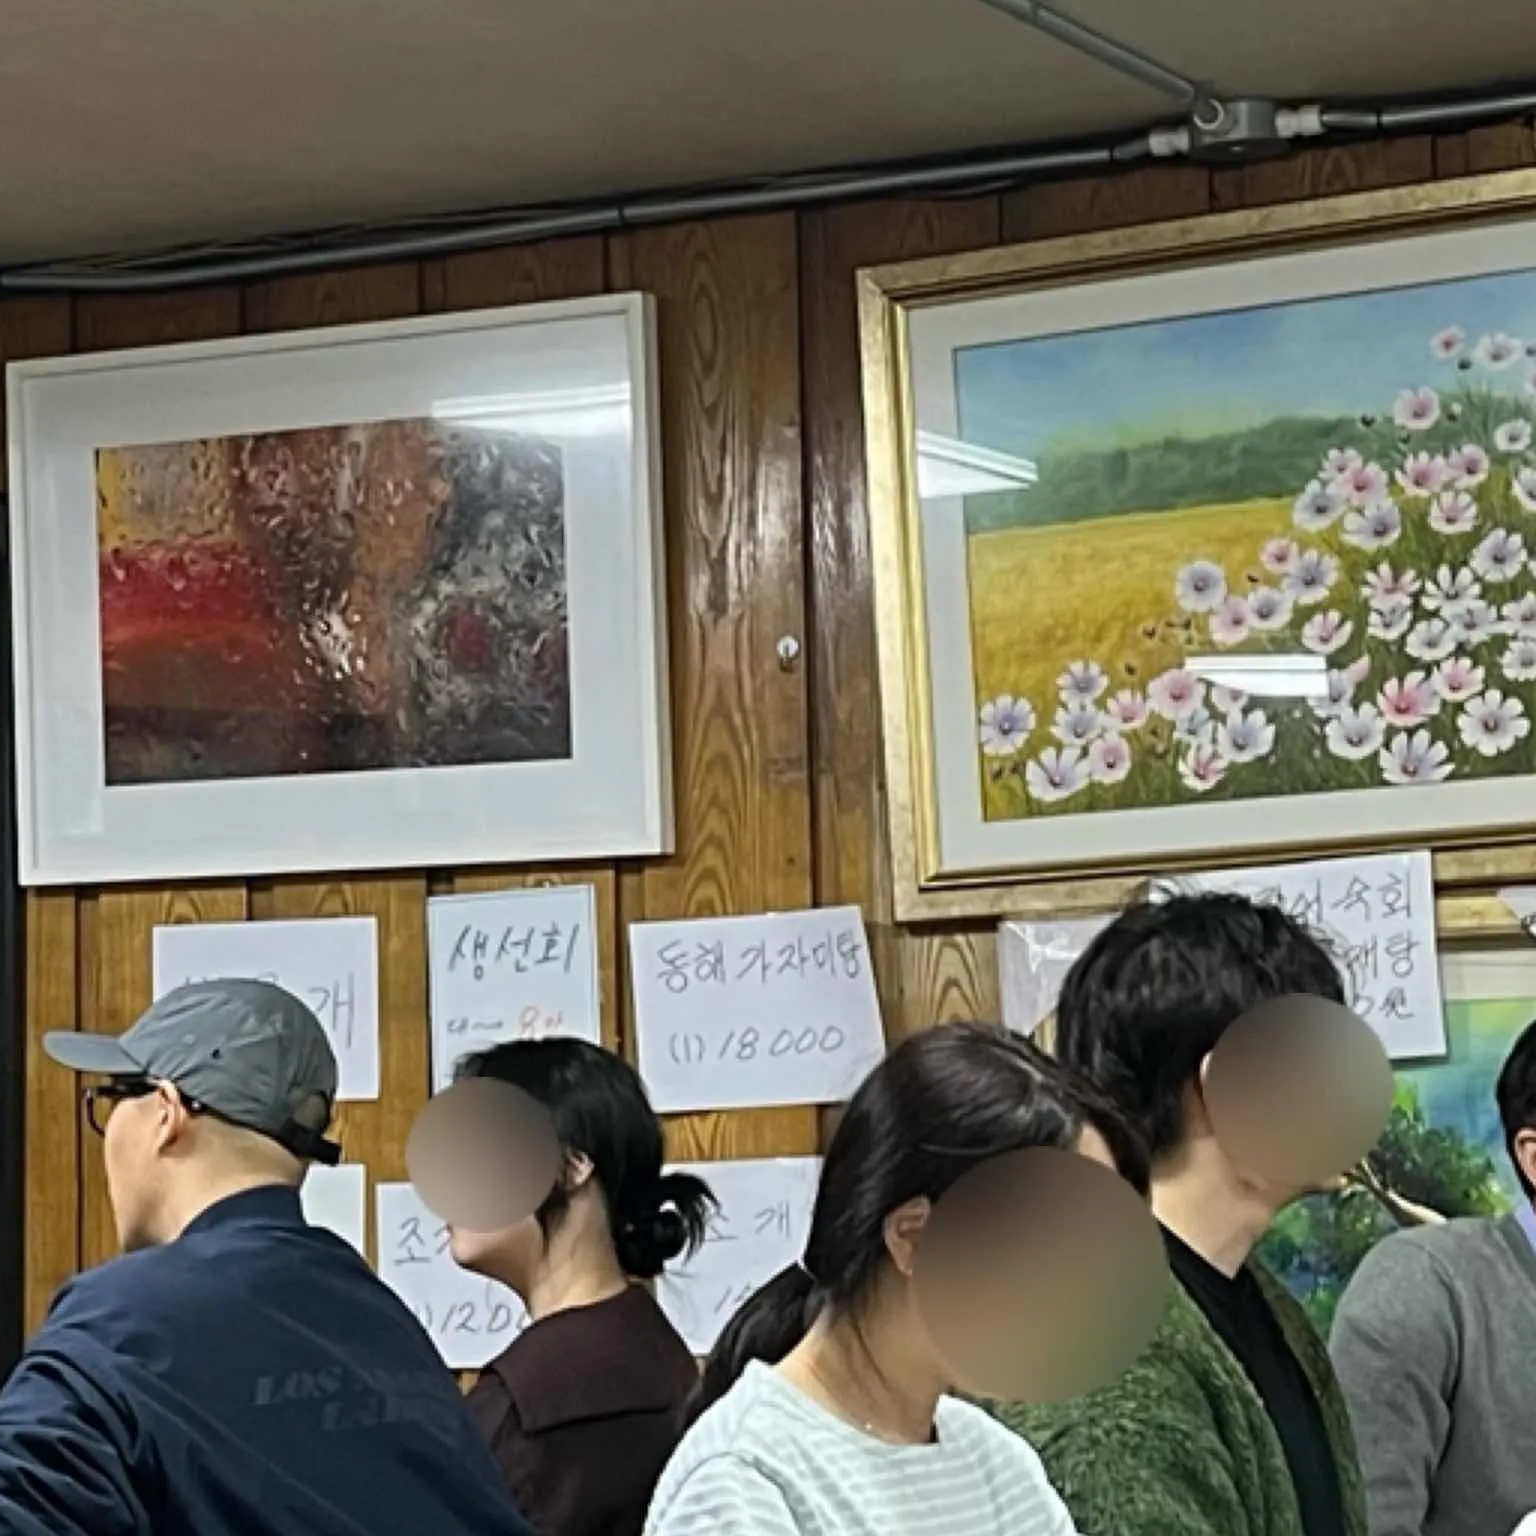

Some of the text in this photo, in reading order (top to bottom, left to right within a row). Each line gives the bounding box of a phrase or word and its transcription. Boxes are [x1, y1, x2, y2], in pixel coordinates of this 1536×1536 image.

[447, 921, 580, 981] 생선회
[656, 928, 863, 994] 동해 가자미탕
